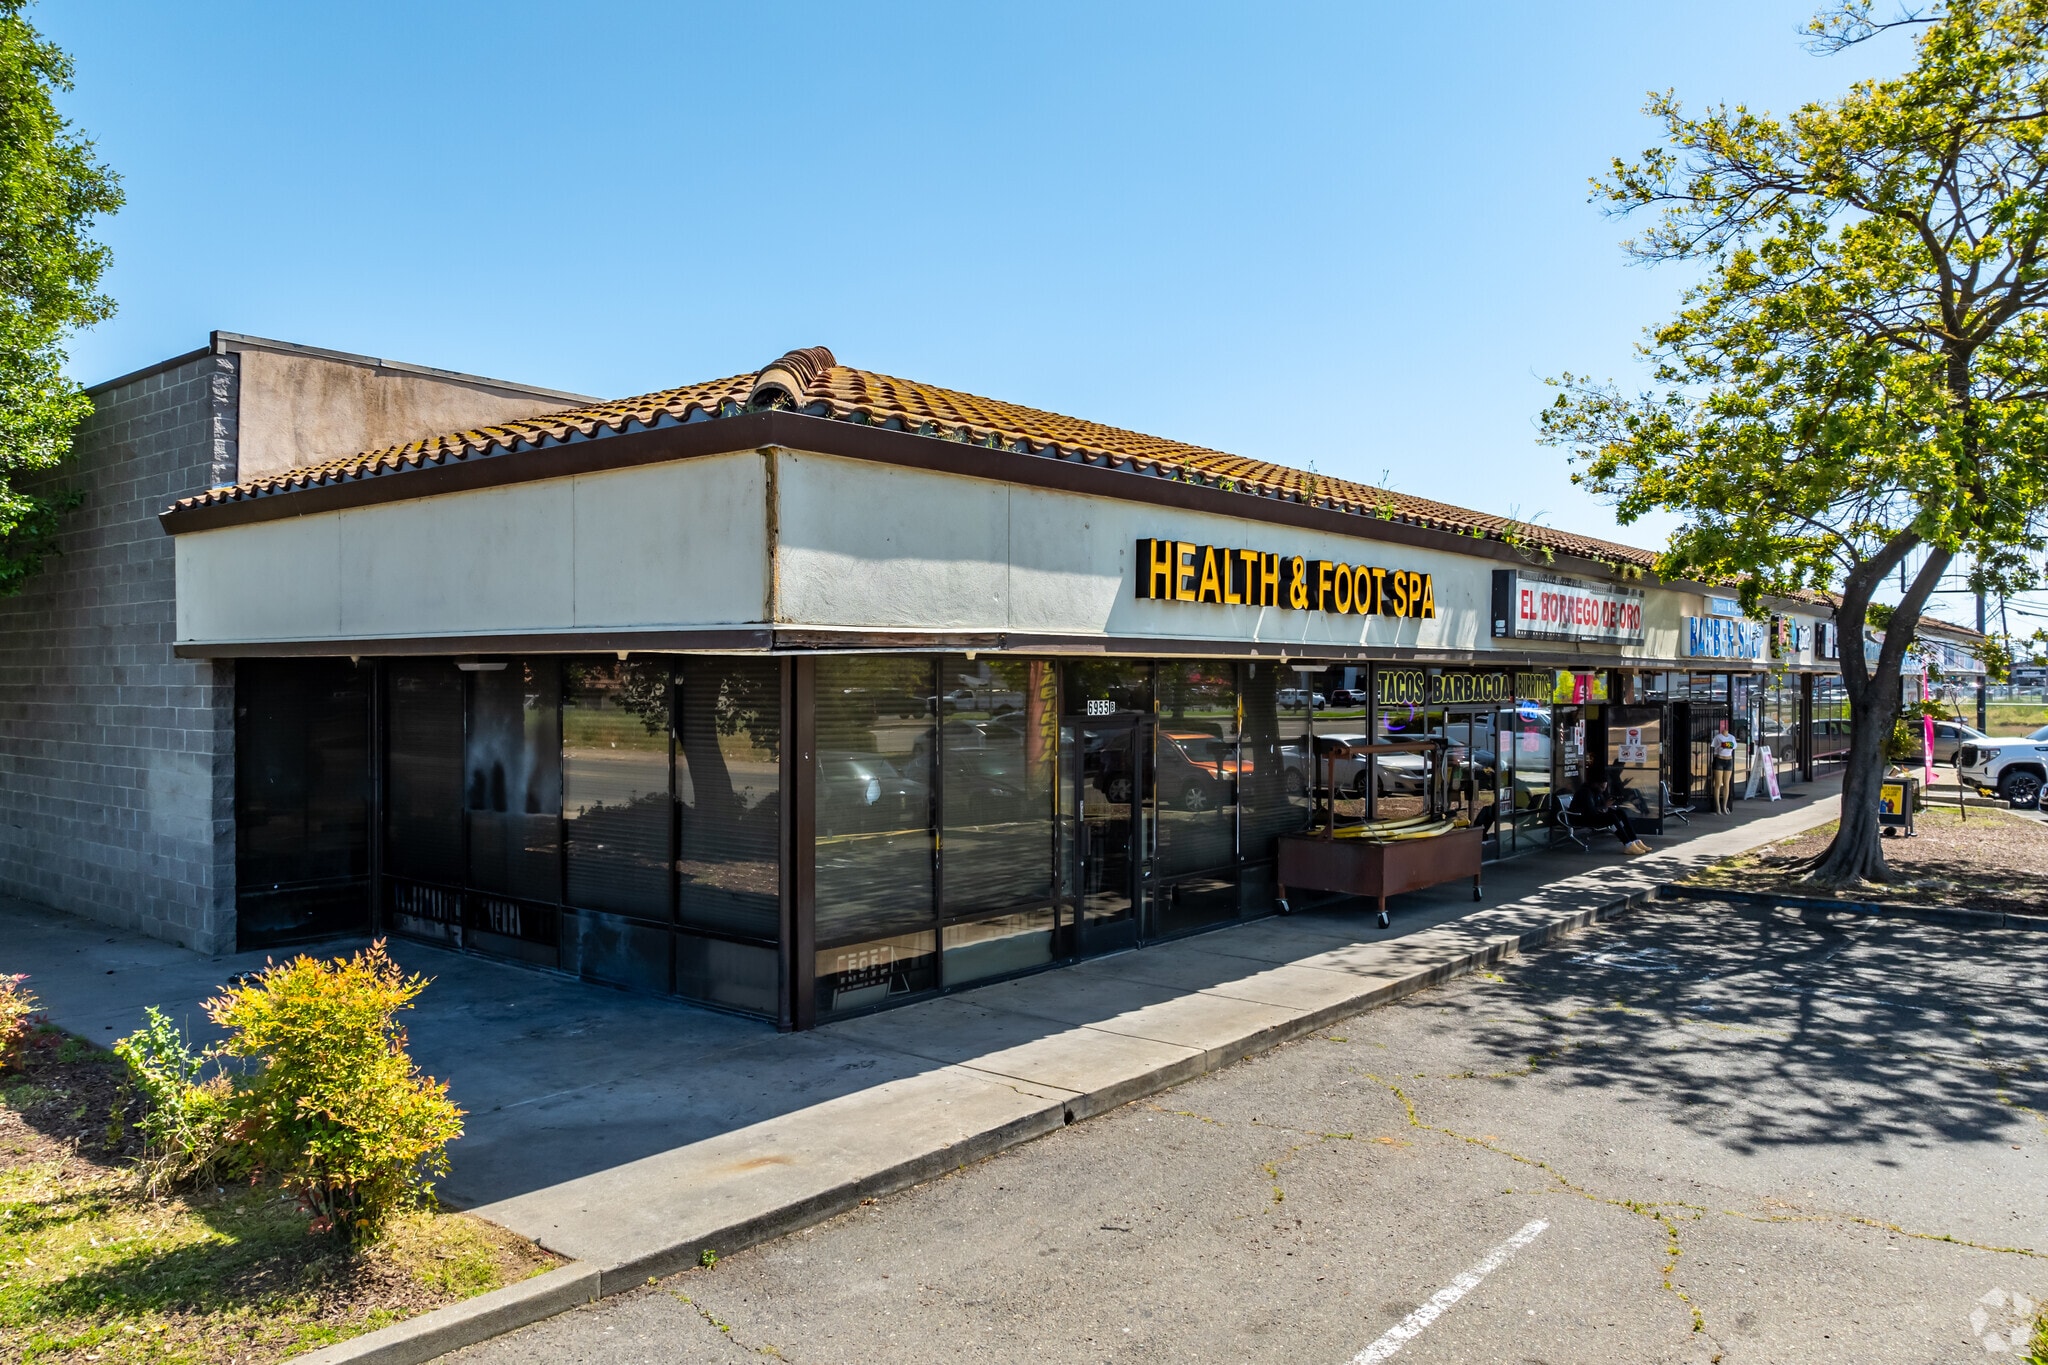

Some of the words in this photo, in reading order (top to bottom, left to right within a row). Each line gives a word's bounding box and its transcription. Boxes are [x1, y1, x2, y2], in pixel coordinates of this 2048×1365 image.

[1149, 537, 1280, 607] HEALTH
[1289, 554, 1308, 610] &
[1317, 560, 1388, 616] FOOT
[1392, 569, 1437, 619] SPA
[1520, 589, 1537, 620] EL
[1541, 591, 1600, 627] BORREGO
[1602, 600, 1617, 629] DE
[1619, 602, 1641, 630] ORO
[1690, 616, 1735, 659] BARBER
[1737, 620, 1764, 660] SHOP
[1088, 700, 1109, 715] 6955
[1110, 702, 1116, 712] B
[1377, 670, 1425, 705] TACOS
[1431, 673, 1511, 704] BARBACOA
[1517, 672, 1549, 700] BURRITOS
